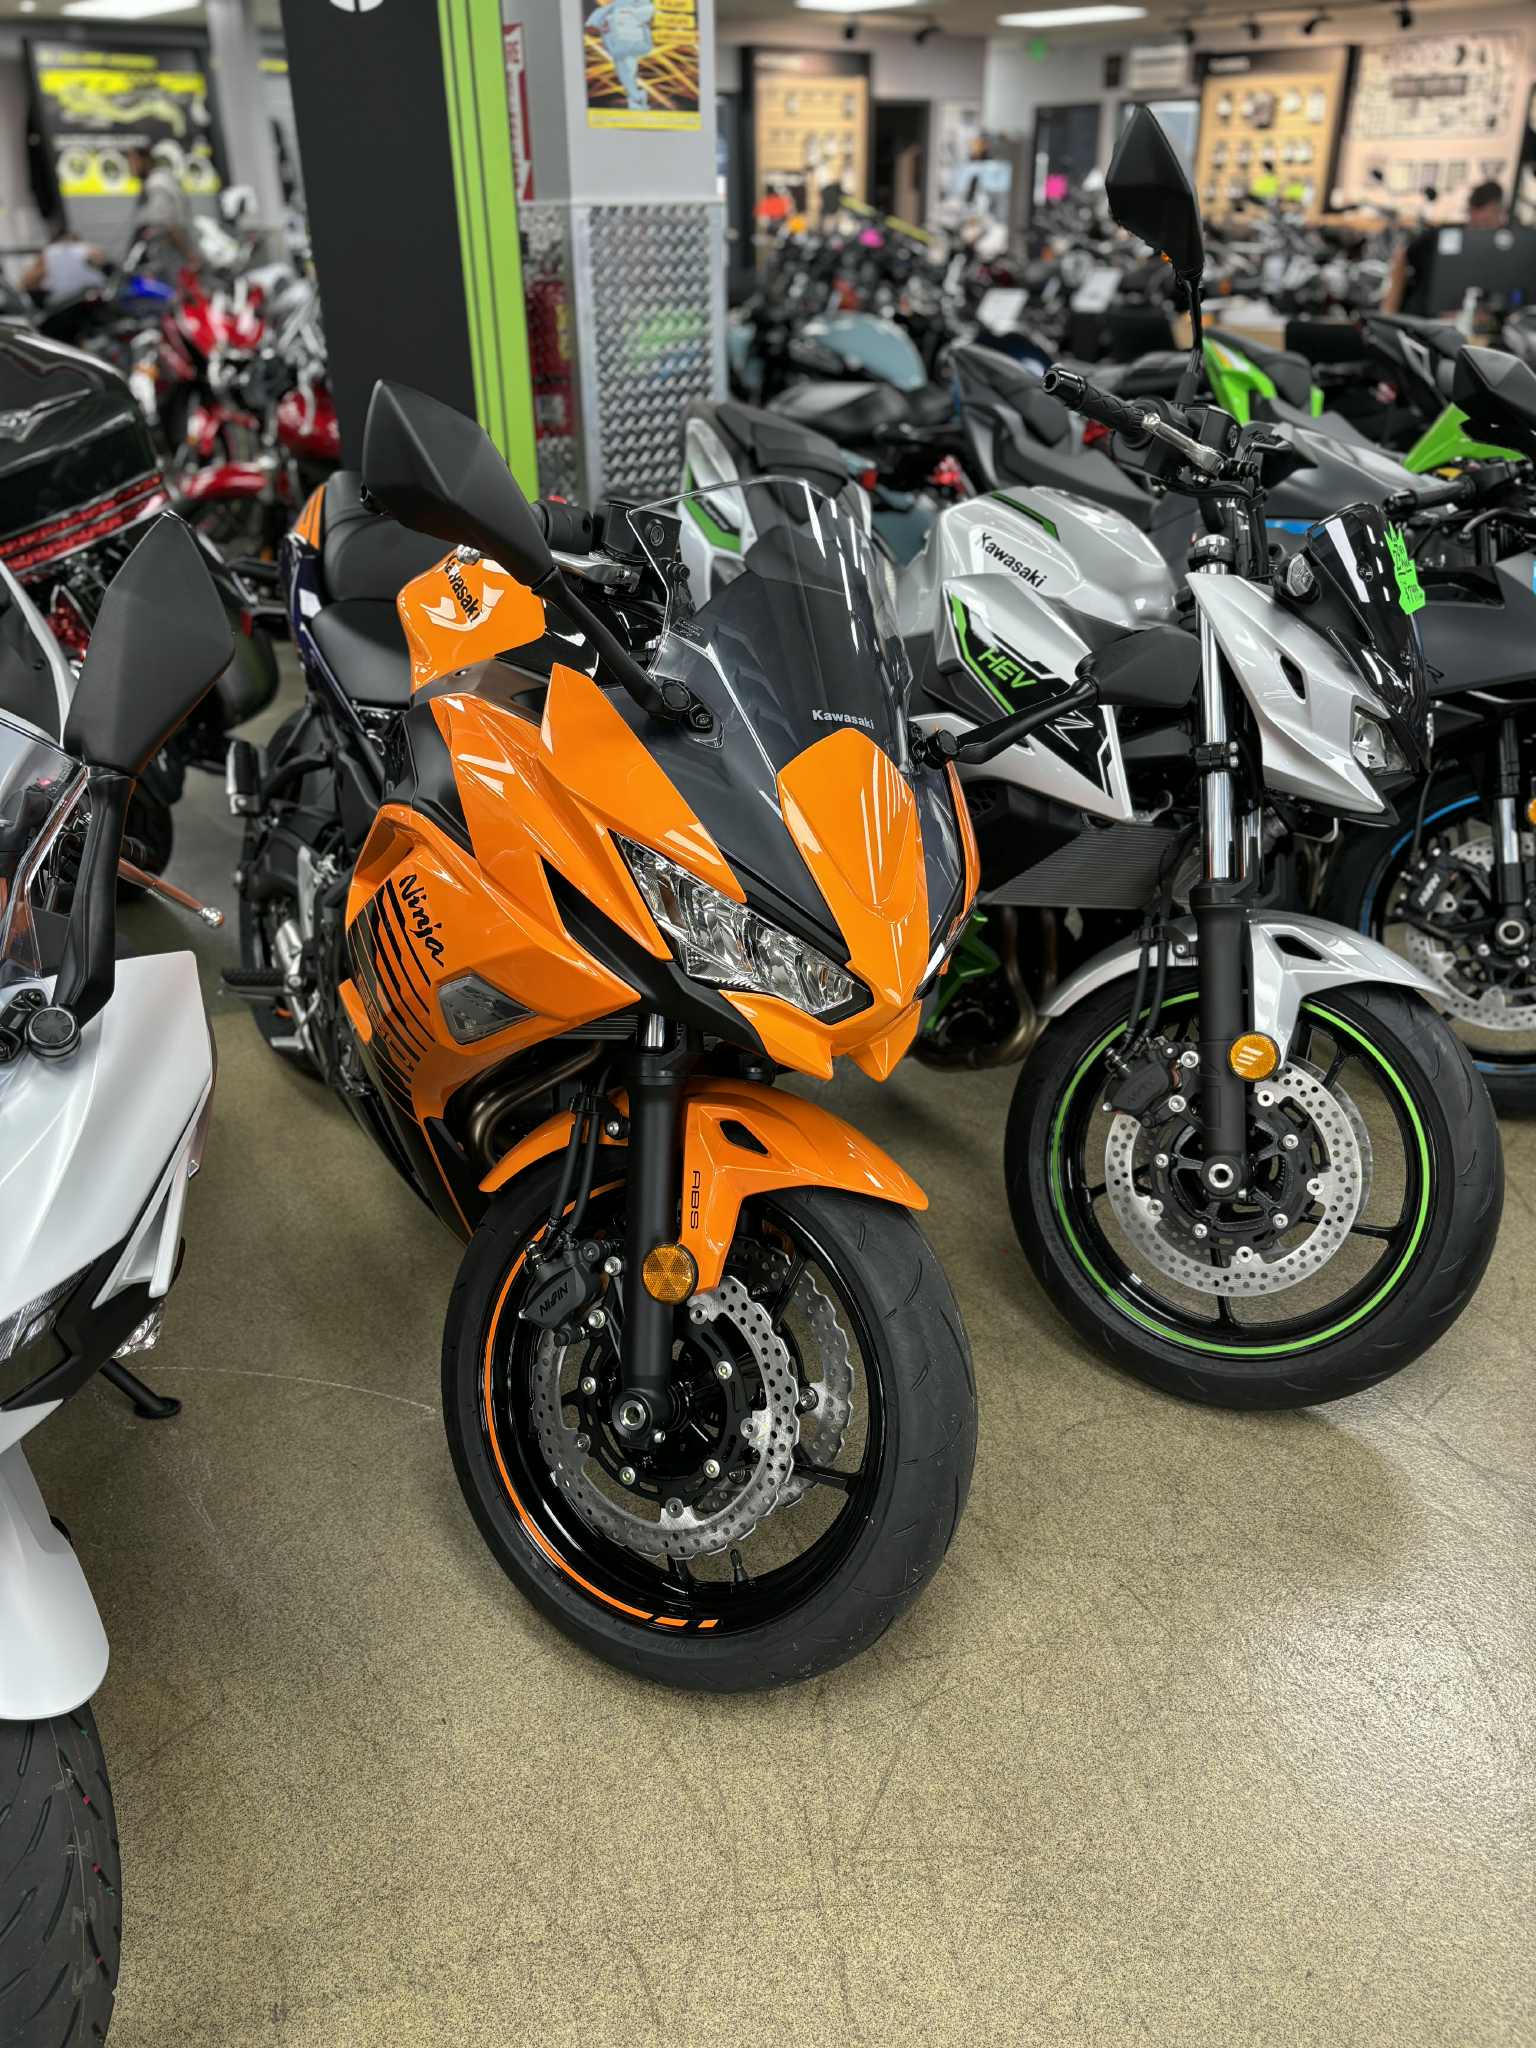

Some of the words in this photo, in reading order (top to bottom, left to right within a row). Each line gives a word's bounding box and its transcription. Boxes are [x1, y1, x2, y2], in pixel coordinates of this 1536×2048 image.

[979, 532, 1048, 589] Kawasaki
[977, 646, 1038, 689] HEV
[812, 709, 875, 729] Kawasaki
[398, 874, 445, 968] Ninja
[691, 1170, 700, 1229] ABS
